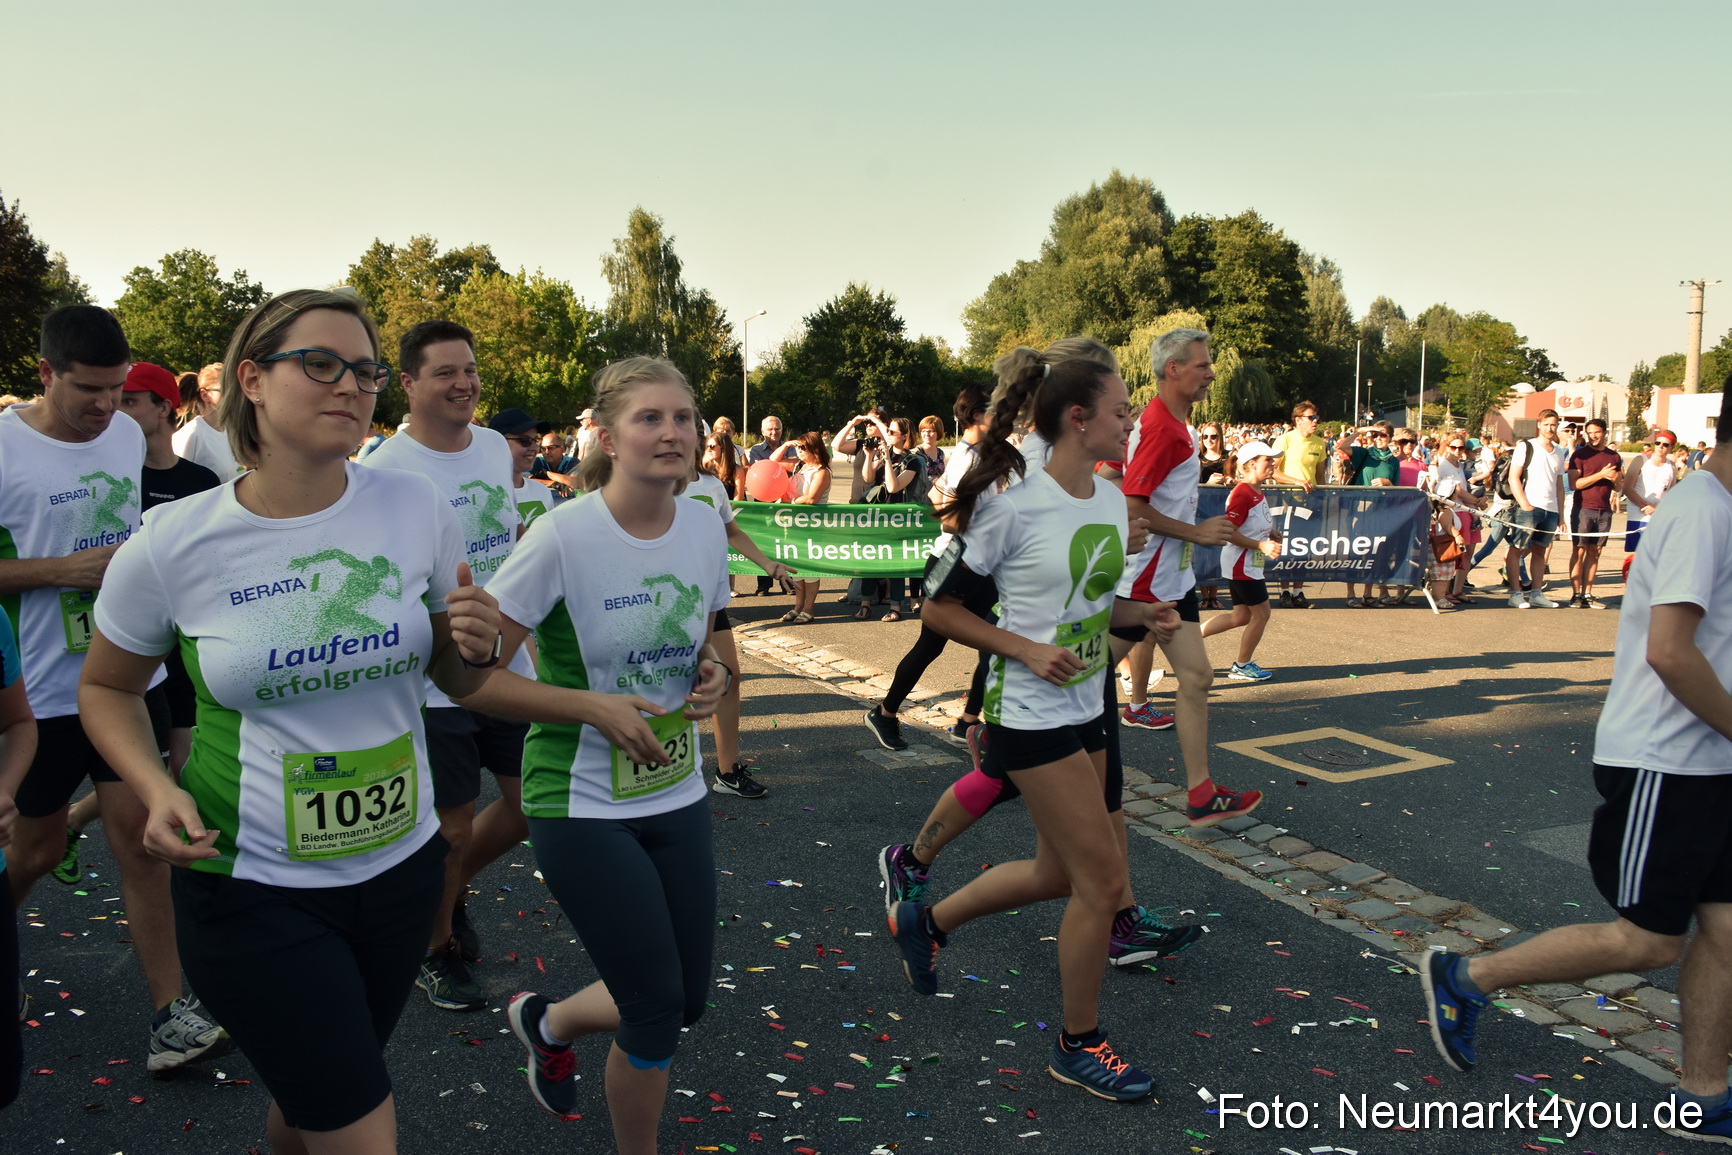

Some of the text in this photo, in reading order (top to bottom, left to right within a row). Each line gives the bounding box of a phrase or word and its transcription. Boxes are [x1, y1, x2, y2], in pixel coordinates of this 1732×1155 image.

[50, 487, 90, 505] BERATA
[774, 508, 924, 528] Gesundheit
[73, 524, 132, 552] Laufend
[775, 538, 936, 560] in besten Hä
[1272, 559, 1375, 571] AUTOMOBILE
[229, 577, 306, 606] BERATA
[604, 593, 653, 611] BERATA
[267, 623, 400, 671] Laufend
[627, 640, 697, 665] Laufend
[255, 652, 420, 701] erfolgreich
[304, 767, 358, 780] firmenlauf
[306, 776, 406, 830] 1032
[301, 828, 369, 843] Biedermann
[372, 810, 410, 832] Katharina
[313, 841, 339, 850] Landw.
[341, 826, 400, 847] Buchführungsdienst
